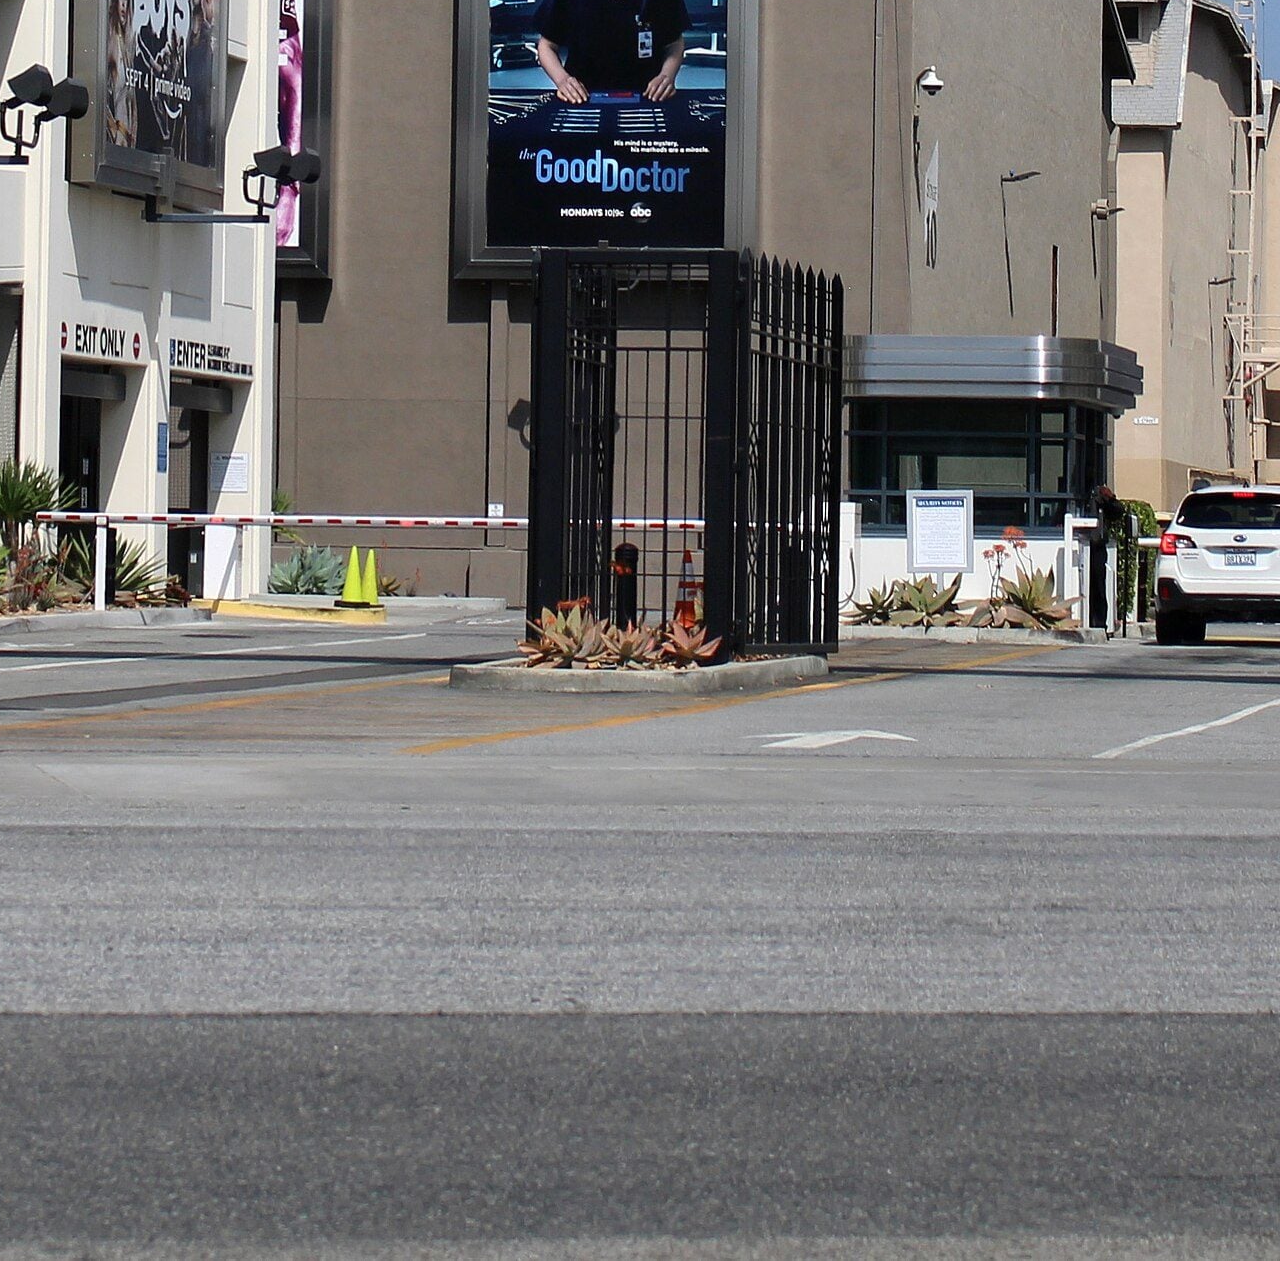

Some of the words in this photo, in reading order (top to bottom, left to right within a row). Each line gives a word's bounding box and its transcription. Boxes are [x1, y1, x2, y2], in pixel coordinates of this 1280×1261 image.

[125, 67, 143, 89] SEPT
[144, 73, 149, 91] 4
[154, 73, 173, 97] prime
[174, 78, 191, 101] video
[519, 148, 537, 160] the
[613, 139, 624, 147] His
[624, 139, 640, 147] mind
[641, 139, 646, 147] is
[535, 148, 601, 184] Good
[601, 158, 691, 193] Doctor
[560, 208, 604, 217] MONDAYS
[630, 205, 652, 217] abc
[926, 208, 937, 270] 10
[75, 323, 98, 355] EXIT
[100, 327, 126, 358] ONLY
[177, 340, 206, 371] ENTER
